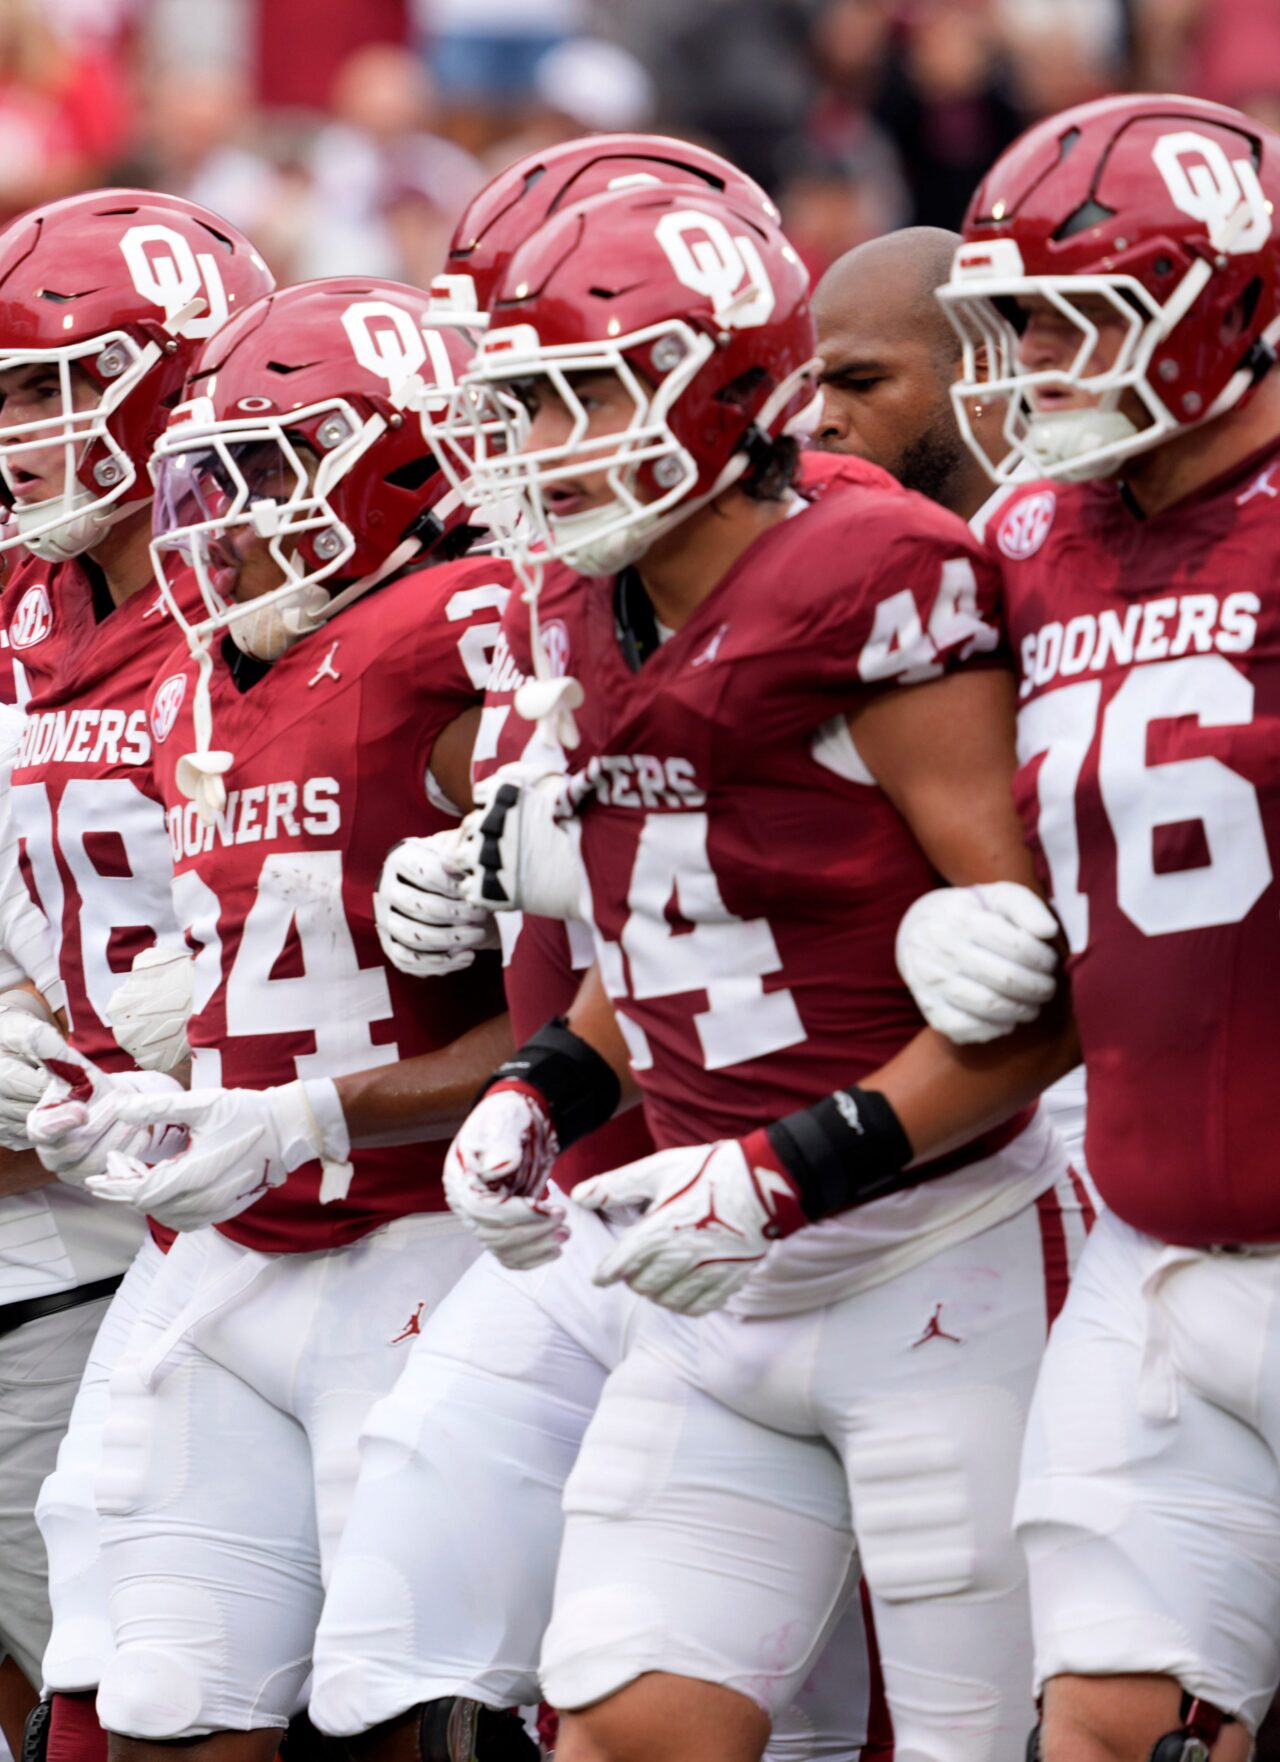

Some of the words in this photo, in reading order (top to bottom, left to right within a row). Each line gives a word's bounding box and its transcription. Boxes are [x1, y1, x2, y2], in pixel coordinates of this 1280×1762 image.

[1151, 131, 1272, 256] OU
[118, 224, 229, 340] OU
[654, 209, 776, 329] OU
[340, 301, 456, 412] OU
[1000, 493, 1054, 556] SEC
[11, 587, 51, 647] SEC
[857, 557, 1000, 685] 44
[1019, 592, 1261, 698] SOONERS
[166, 776, 341, 864] OONERS
[1016, 653, 1273, 954] 76
[578, 812, 808, 1070] 4
